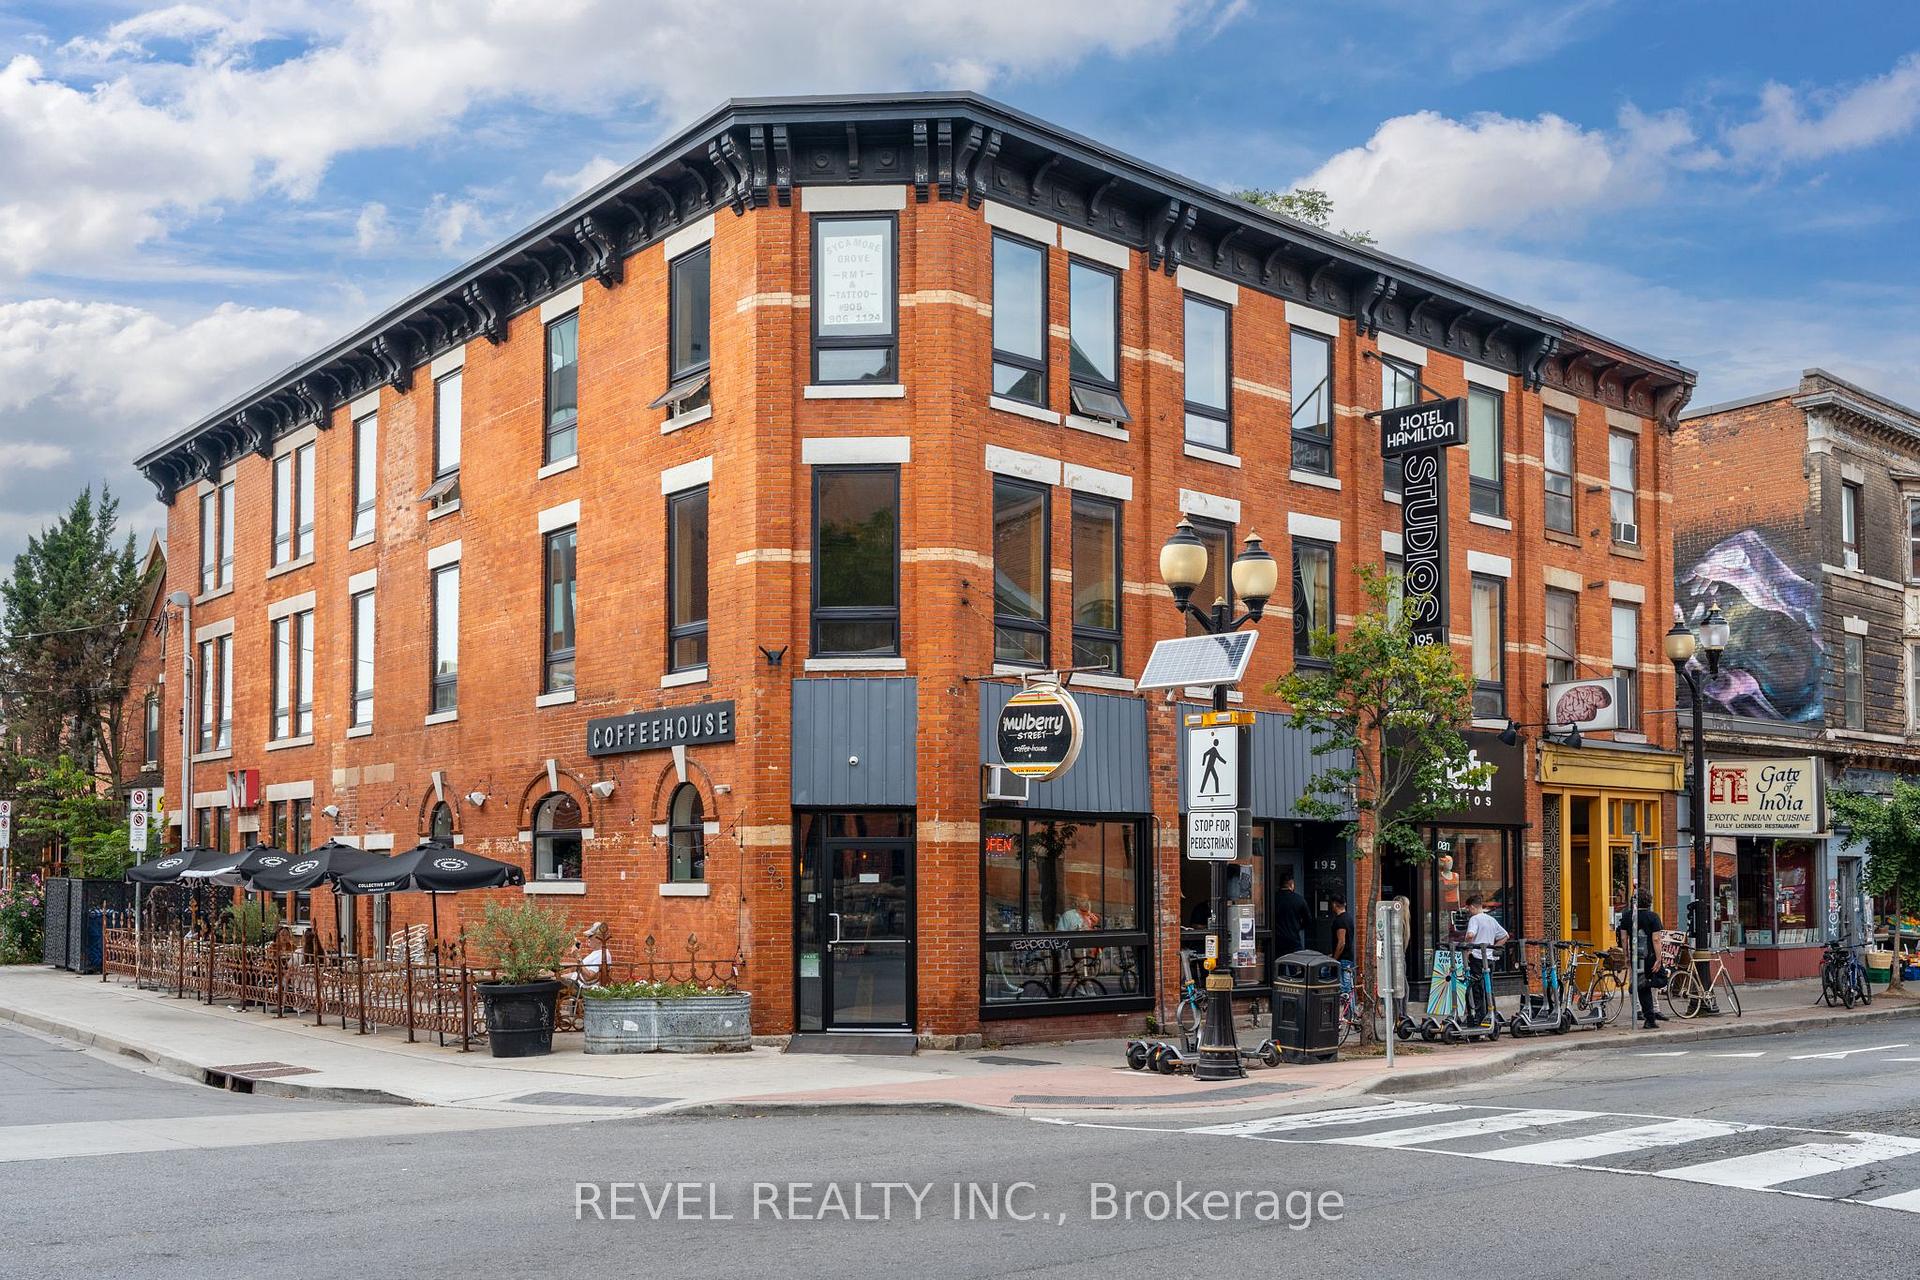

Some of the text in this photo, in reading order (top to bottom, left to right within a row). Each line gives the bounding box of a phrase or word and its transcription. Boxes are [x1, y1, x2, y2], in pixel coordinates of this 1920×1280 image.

[826, 238, 881, 255] SYCAMORE
[837, 254, 870, 263] GROVE
[1400, 410, 1443, 431] HOTEL
[1387, 422, 1454, 448] HAMILTON
[1405, 456, 1438, 622] STUDIOS
[593, 711, 729, 748] COFFEEHOUSE
[1003, 713, 1063, 736] Mulberry
[1017, 731, 1047, 740] STREET
[1756, 765, 1802, 793] Gate
[1759, 793, 1804, 811] India
[1194, 819, 1230, 831] STOP FOR
[1707, 813, 1811, 821] EXOTIC INDIAN CUISINE
[1190, 837, 1234, 849] PEDESTRIANS
[1314, 860, 1336, 870] 195
